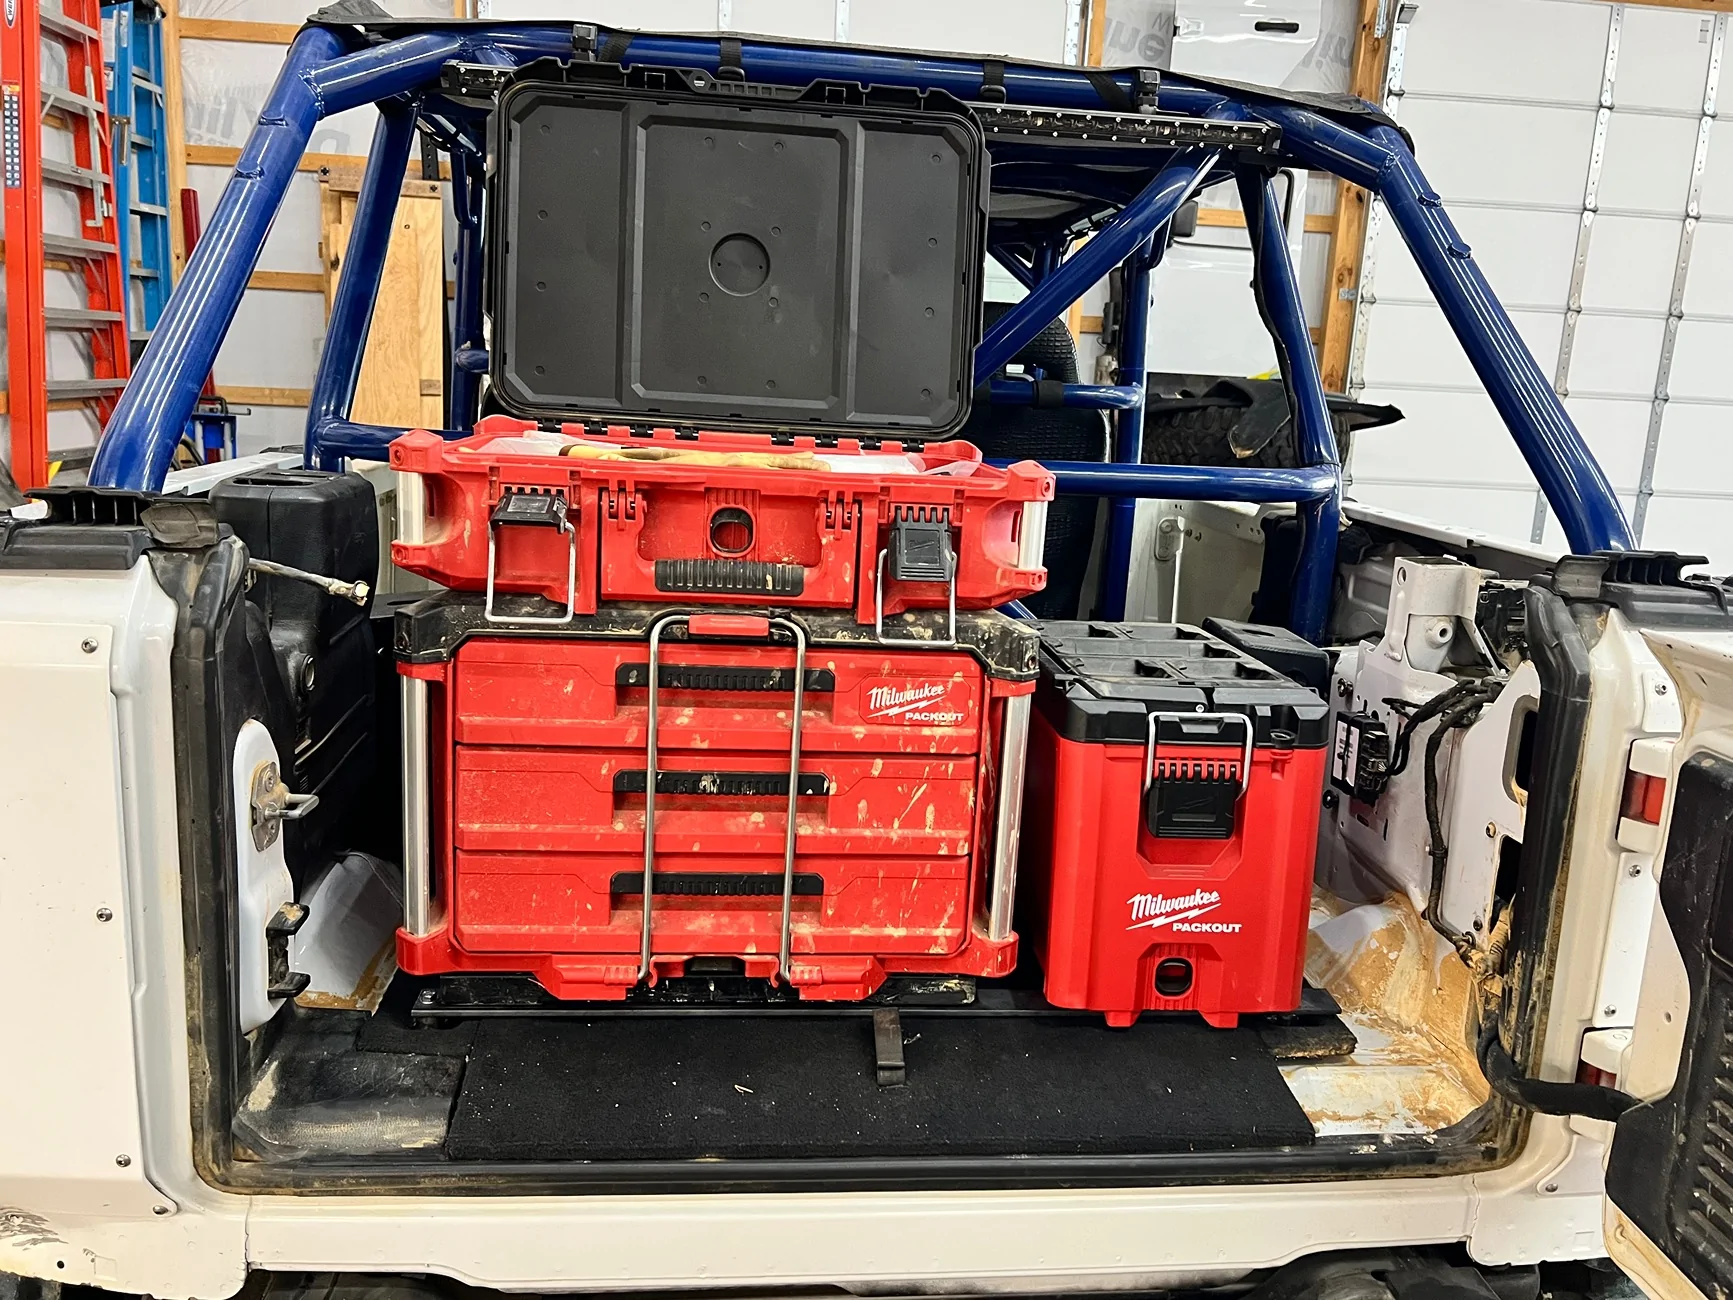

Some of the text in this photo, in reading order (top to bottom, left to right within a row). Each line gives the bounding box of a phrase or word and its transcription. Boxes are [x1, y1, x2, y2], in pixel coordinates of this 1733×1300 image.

[866, 683, 945, 710] Milwaukee
[905, 712, 964, 721] PACKOUT
[1126, 888, 1220, 921] Milwaukee
[1172, 922, 1242, 933] PACKOUT
